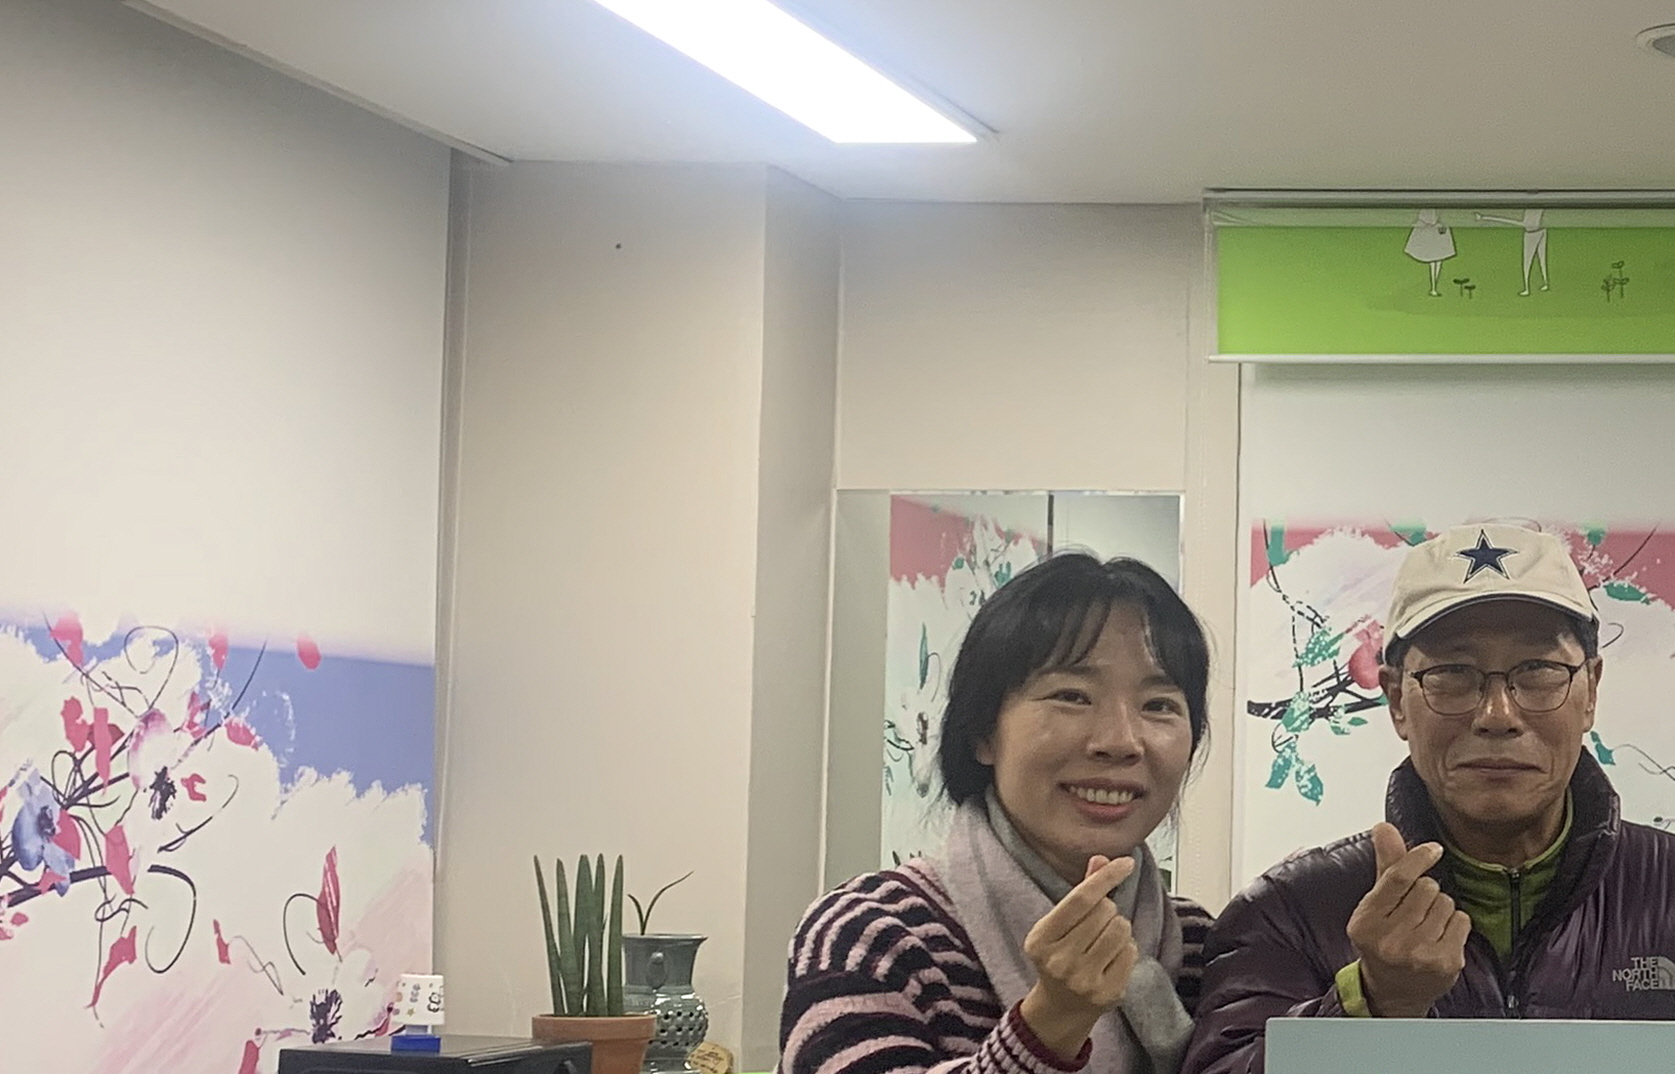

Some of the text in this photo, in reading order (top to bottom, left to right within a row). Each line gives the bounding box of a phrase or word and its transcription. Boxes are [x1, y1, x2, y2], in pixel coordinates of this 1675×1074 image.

[1631, 956, 1659, 969] THE
[1612, 968, 1660, 982] NORTH
[1625, 978, 1660, 992] FACE
